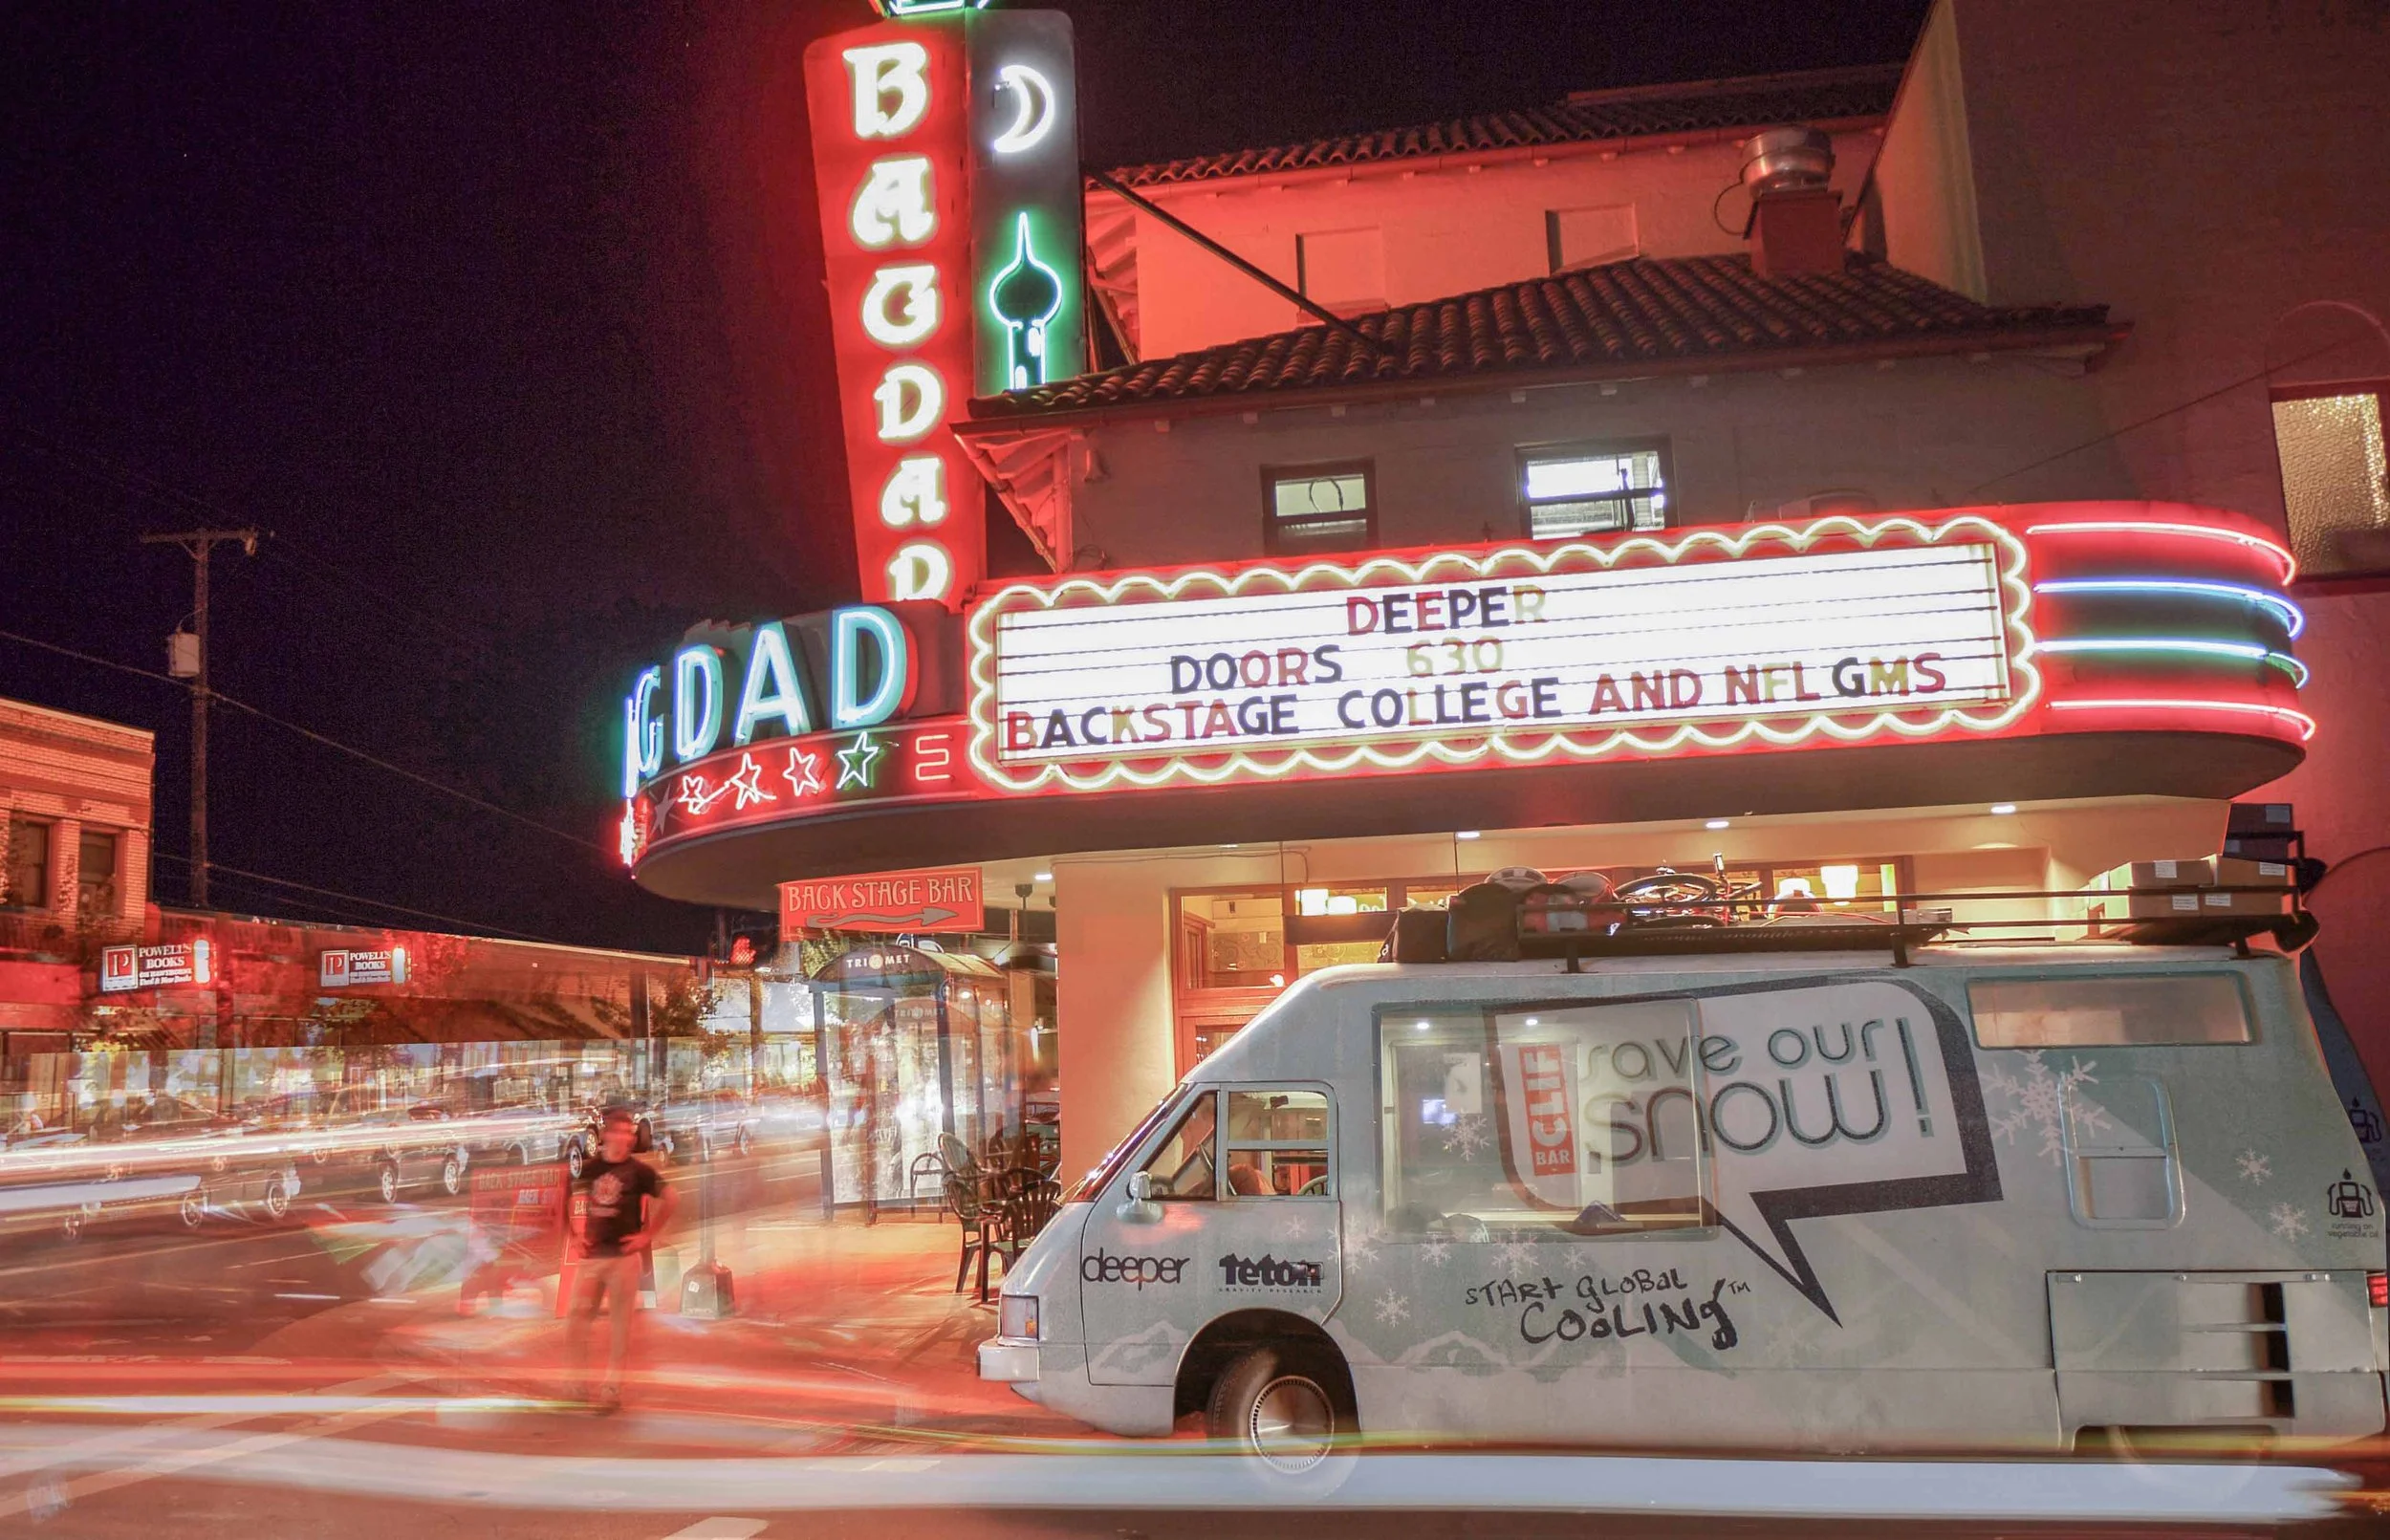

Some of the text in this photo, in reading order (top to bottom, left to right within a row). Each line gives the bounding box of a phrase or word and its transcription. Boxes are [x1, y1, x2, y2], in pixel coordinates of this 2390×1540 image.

[843, 40, 950, 602] BAGDAD
[1348, 585, 1546, 637] DEEPER
[1170, 635, 1505, 695] DOORS 630
[1007, 651, 1947, 751] BACKSTAGE COLLEGE AND NFL GMS
[787, 876, 974, 912] BACK STAGE BAR
[138, 943, 192, 958] POWELL'S
[146, 956, 185, 968] BOOKS
[349, 950, 392, 962] POWELL'S
[355, 960, 386, 971] BOOKS
[1580, 1016, 1882, 1085] save our
[1523, 1044, 1569, 1147] CLIF
[1534, 1148, 1571, 1166] BAR
[1081, 1247, 1190, 1291] deeper
[1218, 1252, 1322, 1287] teton
